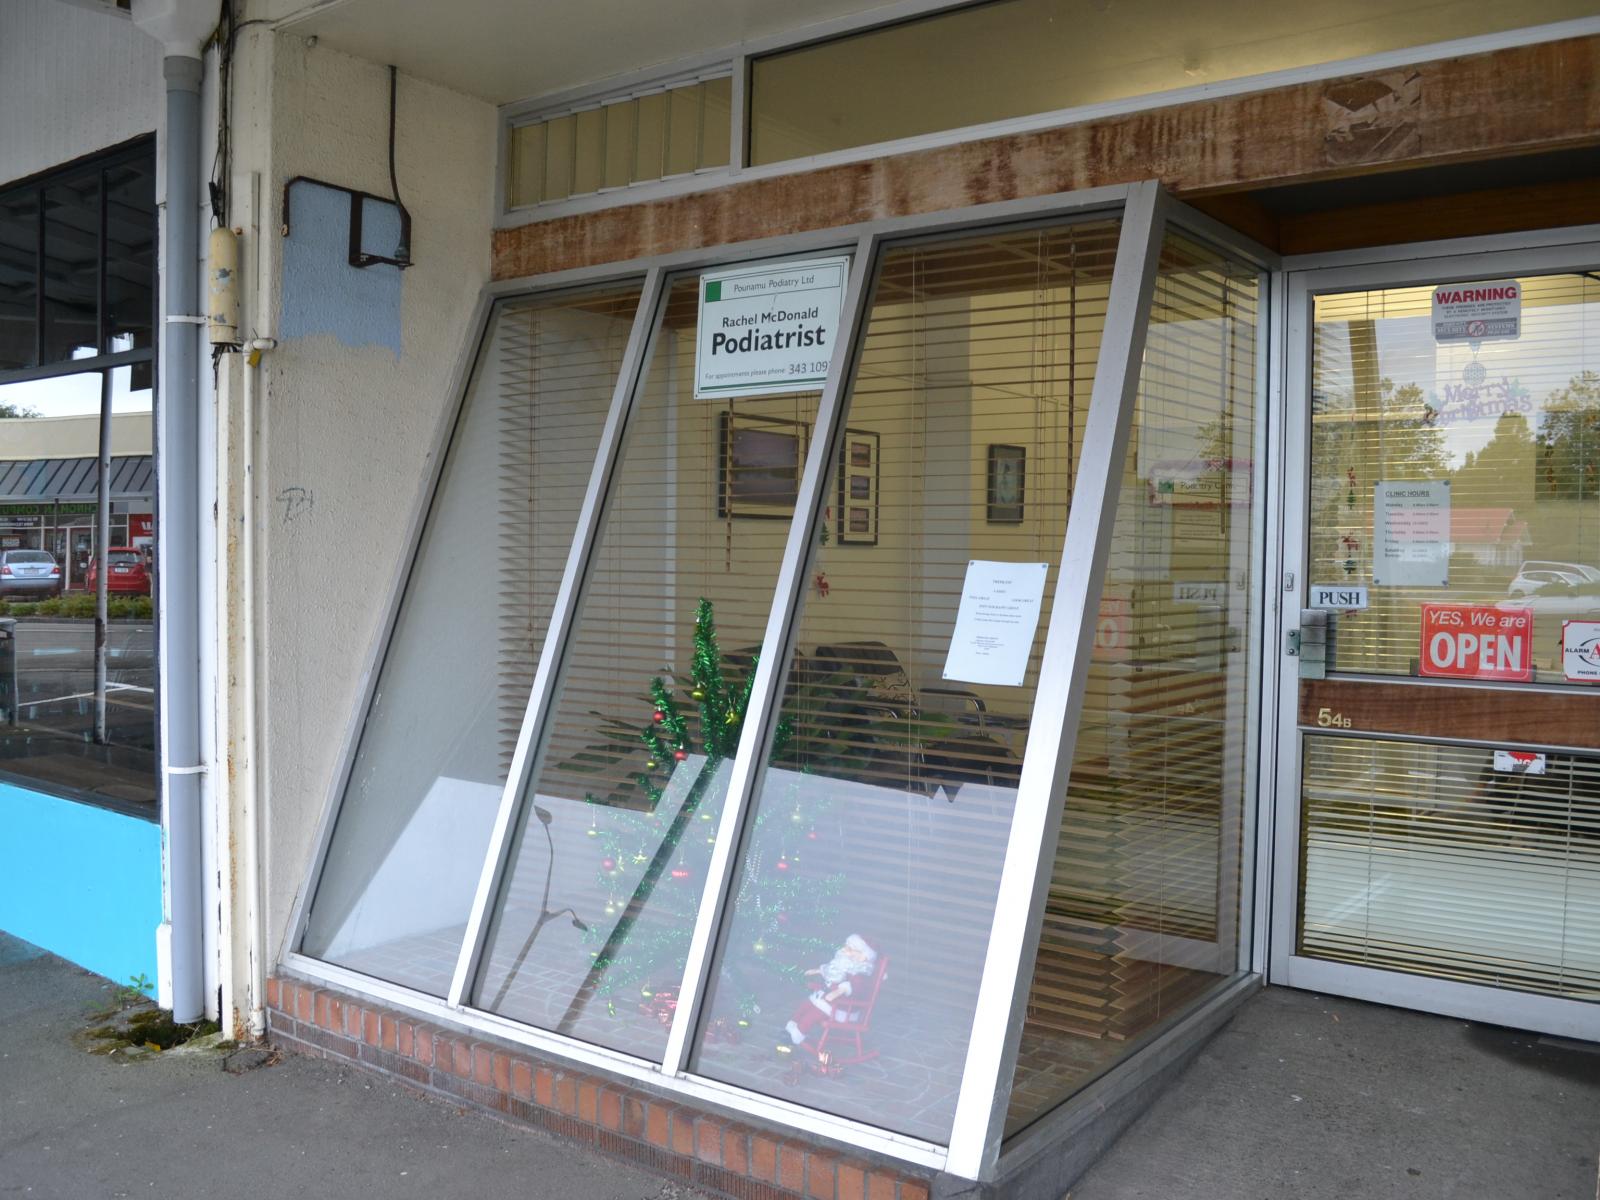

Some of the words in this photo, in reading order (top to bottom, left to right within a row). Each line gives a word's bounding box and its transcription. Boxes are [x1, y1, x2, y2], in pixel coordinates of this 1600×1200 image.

[734, 282, 766, 292] Pounamu
[769, 278, 798, 287] Podiatry
[801, 275, 815, 284] Ltd
[1436, 287, 1517, 304] WARNING
[722, 314, 757, 327] Rachel
[761, 307, 819, 323] McDonald
[712, 324, 826, 356] Podiatrist
[750, 369, 767, 377] please
[767, 368, 785, 376] phone
[789, 362, 807, 375] 343
[810, 361, 832, 373] 109
[1385, 490, 1407, 498] CLINIC
[1408, 490, 1430, 498] HOURS
[1319, 591, 1360, 604] PUSH
[1471, 612, 1496, 626] We
[1500, 616, 1526, 628] are
[1429, 631, 1522, 672] OPEN
[1318, 707, 1352, 728] 54B
